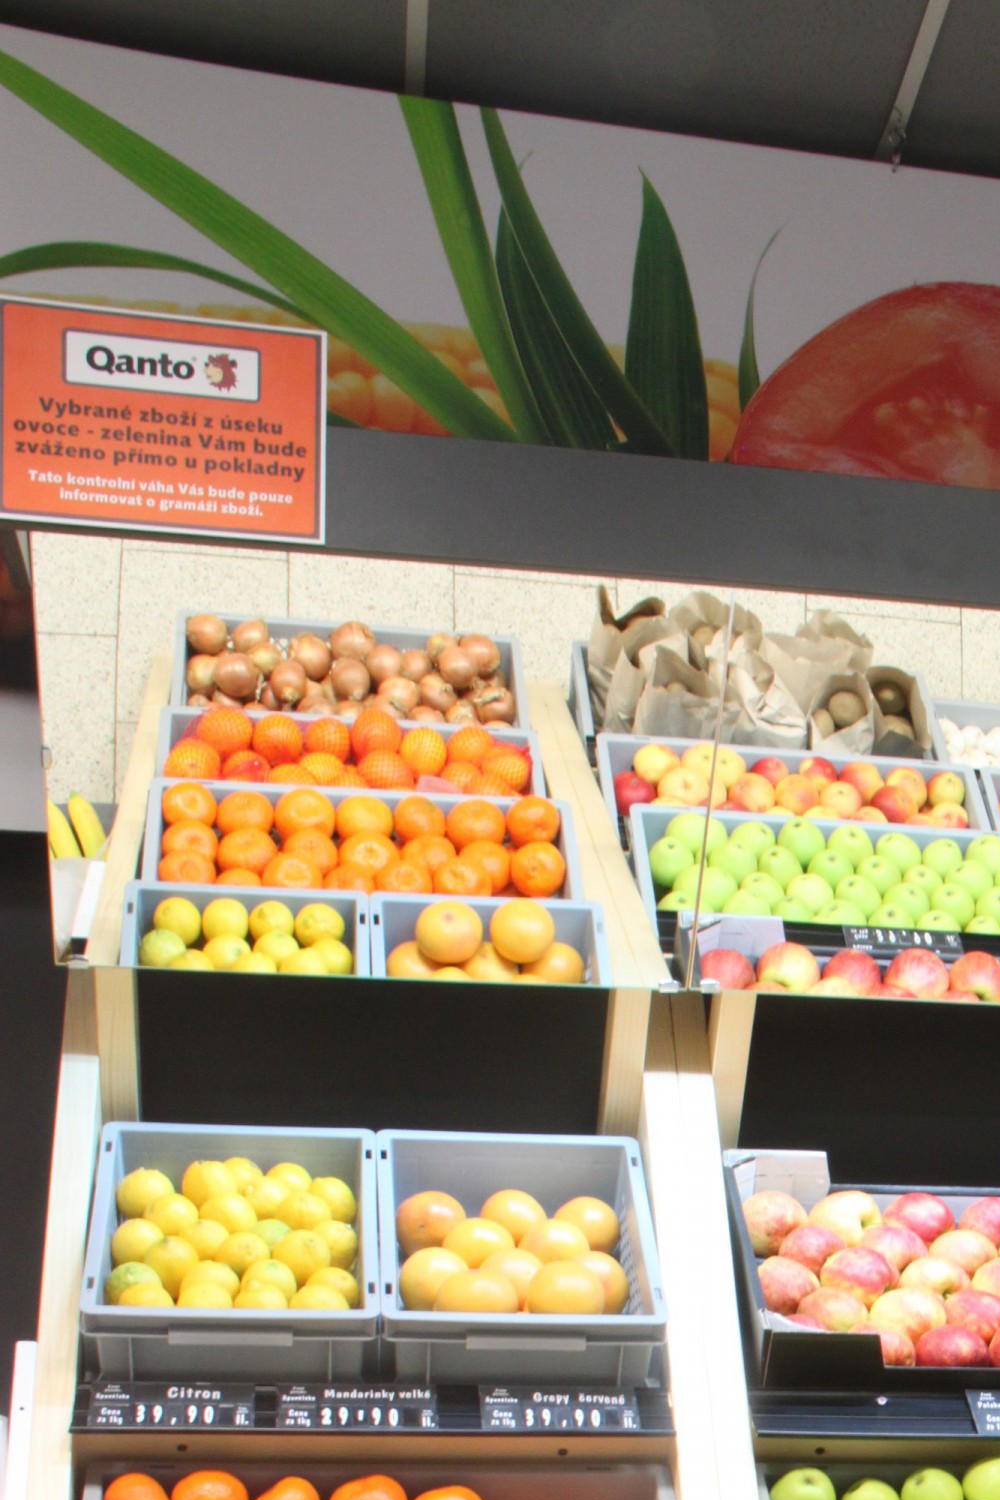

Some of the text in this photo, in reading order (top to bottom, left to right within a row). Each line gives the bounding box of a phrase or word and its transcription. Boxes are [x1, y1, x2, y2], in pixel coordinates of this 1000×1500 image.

[86, 345, 195, 379] Qanto
[39, 397, 283, 435] Vybrané zboží z úseku
[13, 419, 80, 436] ovoce
[101, 425, 191, 448] zelenina
[198, 433, 246, 453] Vám
[253, 438, 307, 458] bude
[15, 440, 305, 483] zváženo přímo u pokladny
[28, 469, 294, 505] Tato kontrolní váha Vás bude pouze
[59, 487, 263, 517] informovat o gramáži zboží.
[167, 1386, 221, 1400] Citron
[323, 1389, 431, 1401] Mandarinky velké
[533, 1391, 626, 1406] Grepy červené
